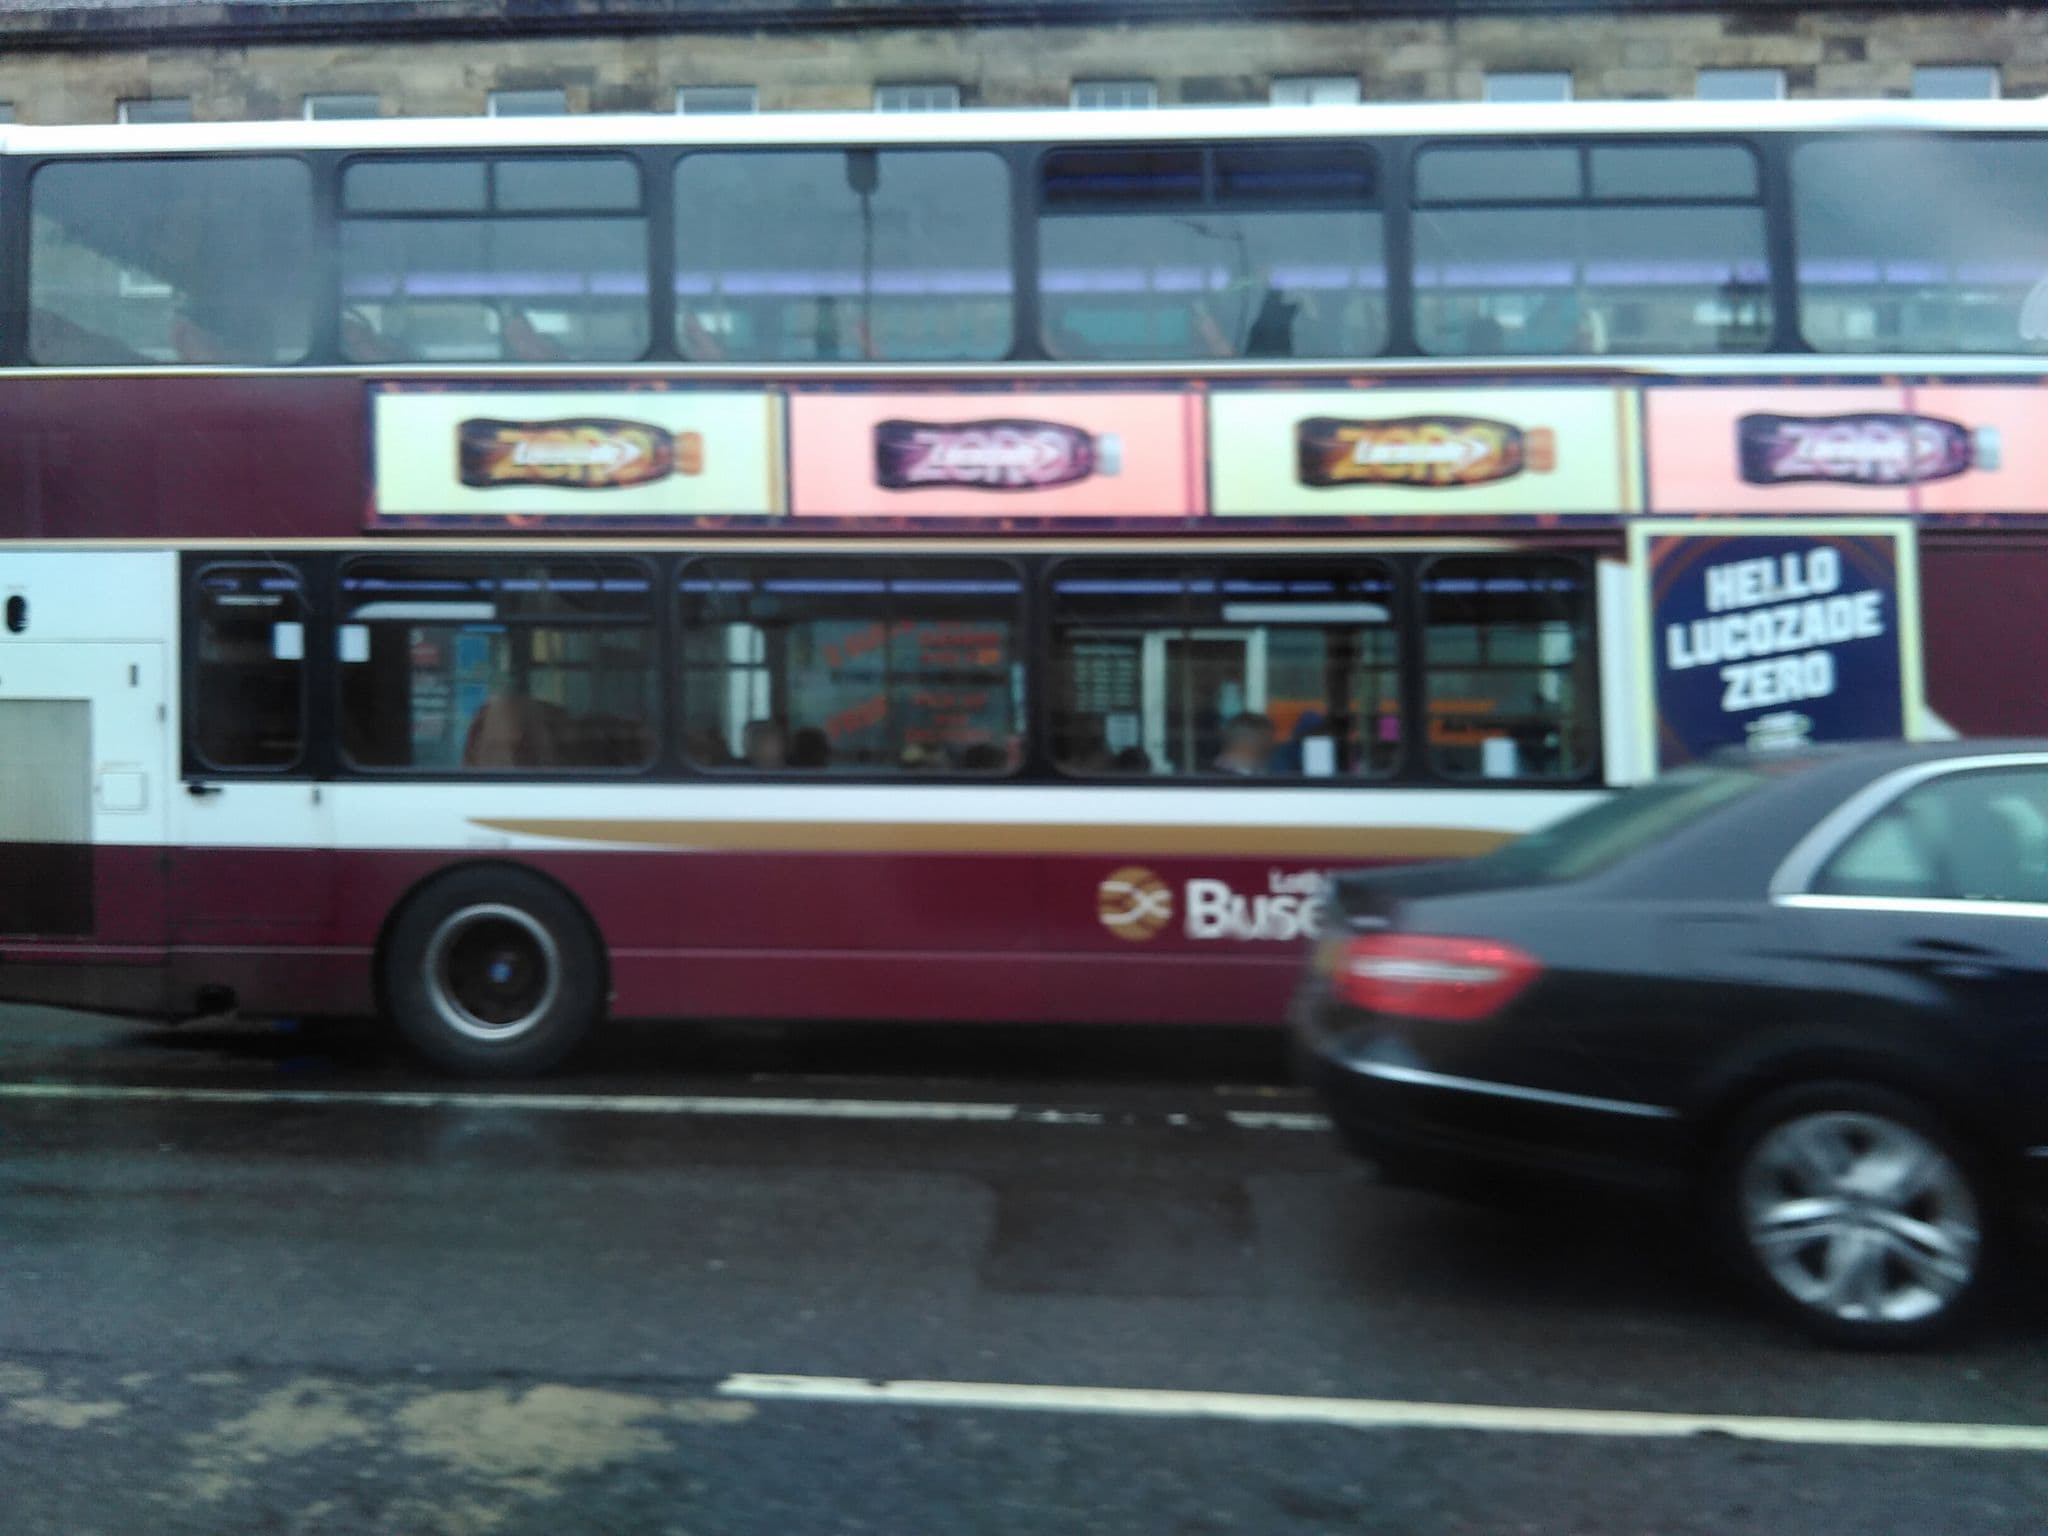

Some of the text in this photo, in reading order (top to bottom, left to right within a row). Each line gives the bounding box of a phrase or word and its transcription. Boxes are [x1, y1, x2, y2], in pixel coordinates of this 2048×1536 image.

[1704, 546, 1840, 613] HELLO
[1666, 590, 1884, 670] LUCOZADE
[1719, 650, 1836, 712] ZERO
